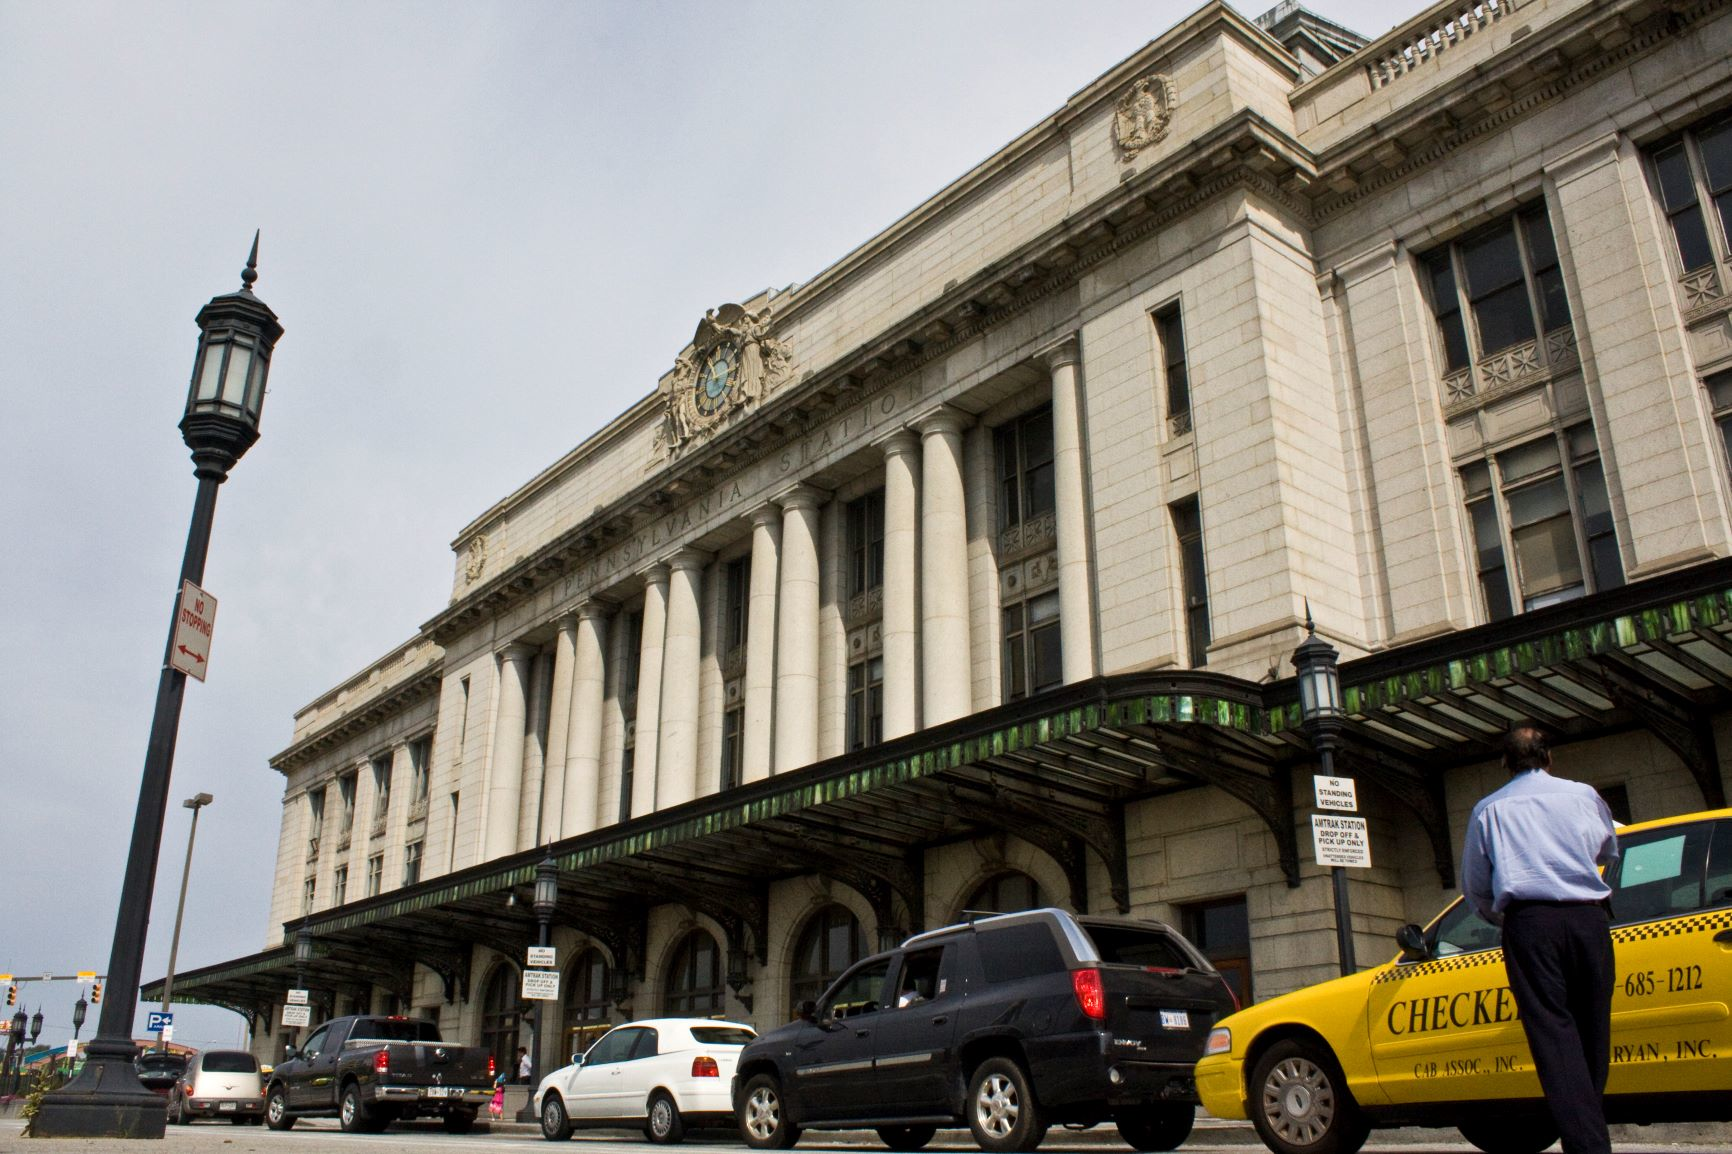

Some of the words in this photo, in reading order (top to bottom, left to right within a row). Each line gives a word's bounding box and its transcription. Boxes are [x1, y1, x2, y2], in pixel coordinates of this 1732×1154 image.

[564, 481, 742, 597] PENNSYLVANIA
[194, 598, 205, 615] NO
[181, 608, 211, 637] STOPPING
[1319, 789, 1353, 798] STANDING
[1320, 799, 1354, 808] VEHICLES
[1314, 818, 1340, 829] AMTRAK
[1340, 819, 1366, 831] STATION
[1320, 830, 1339, 838] DROP
[1339, 831, 1353, 839] OFF
[1318, 837, 1335, 845] PICK
[1336, 838, 1345, 846] UP
[1346, 839, 1364, 847] ONLY
[1387, 985, 1521, 1035] CHECKE
[149, 1014, 162, 1028] P
[1414, 1061, 1437, 1079] CAB
[1495, 1055, 1523, 1073] INC.
[1676, 1039, 1717, 1060] INC.
